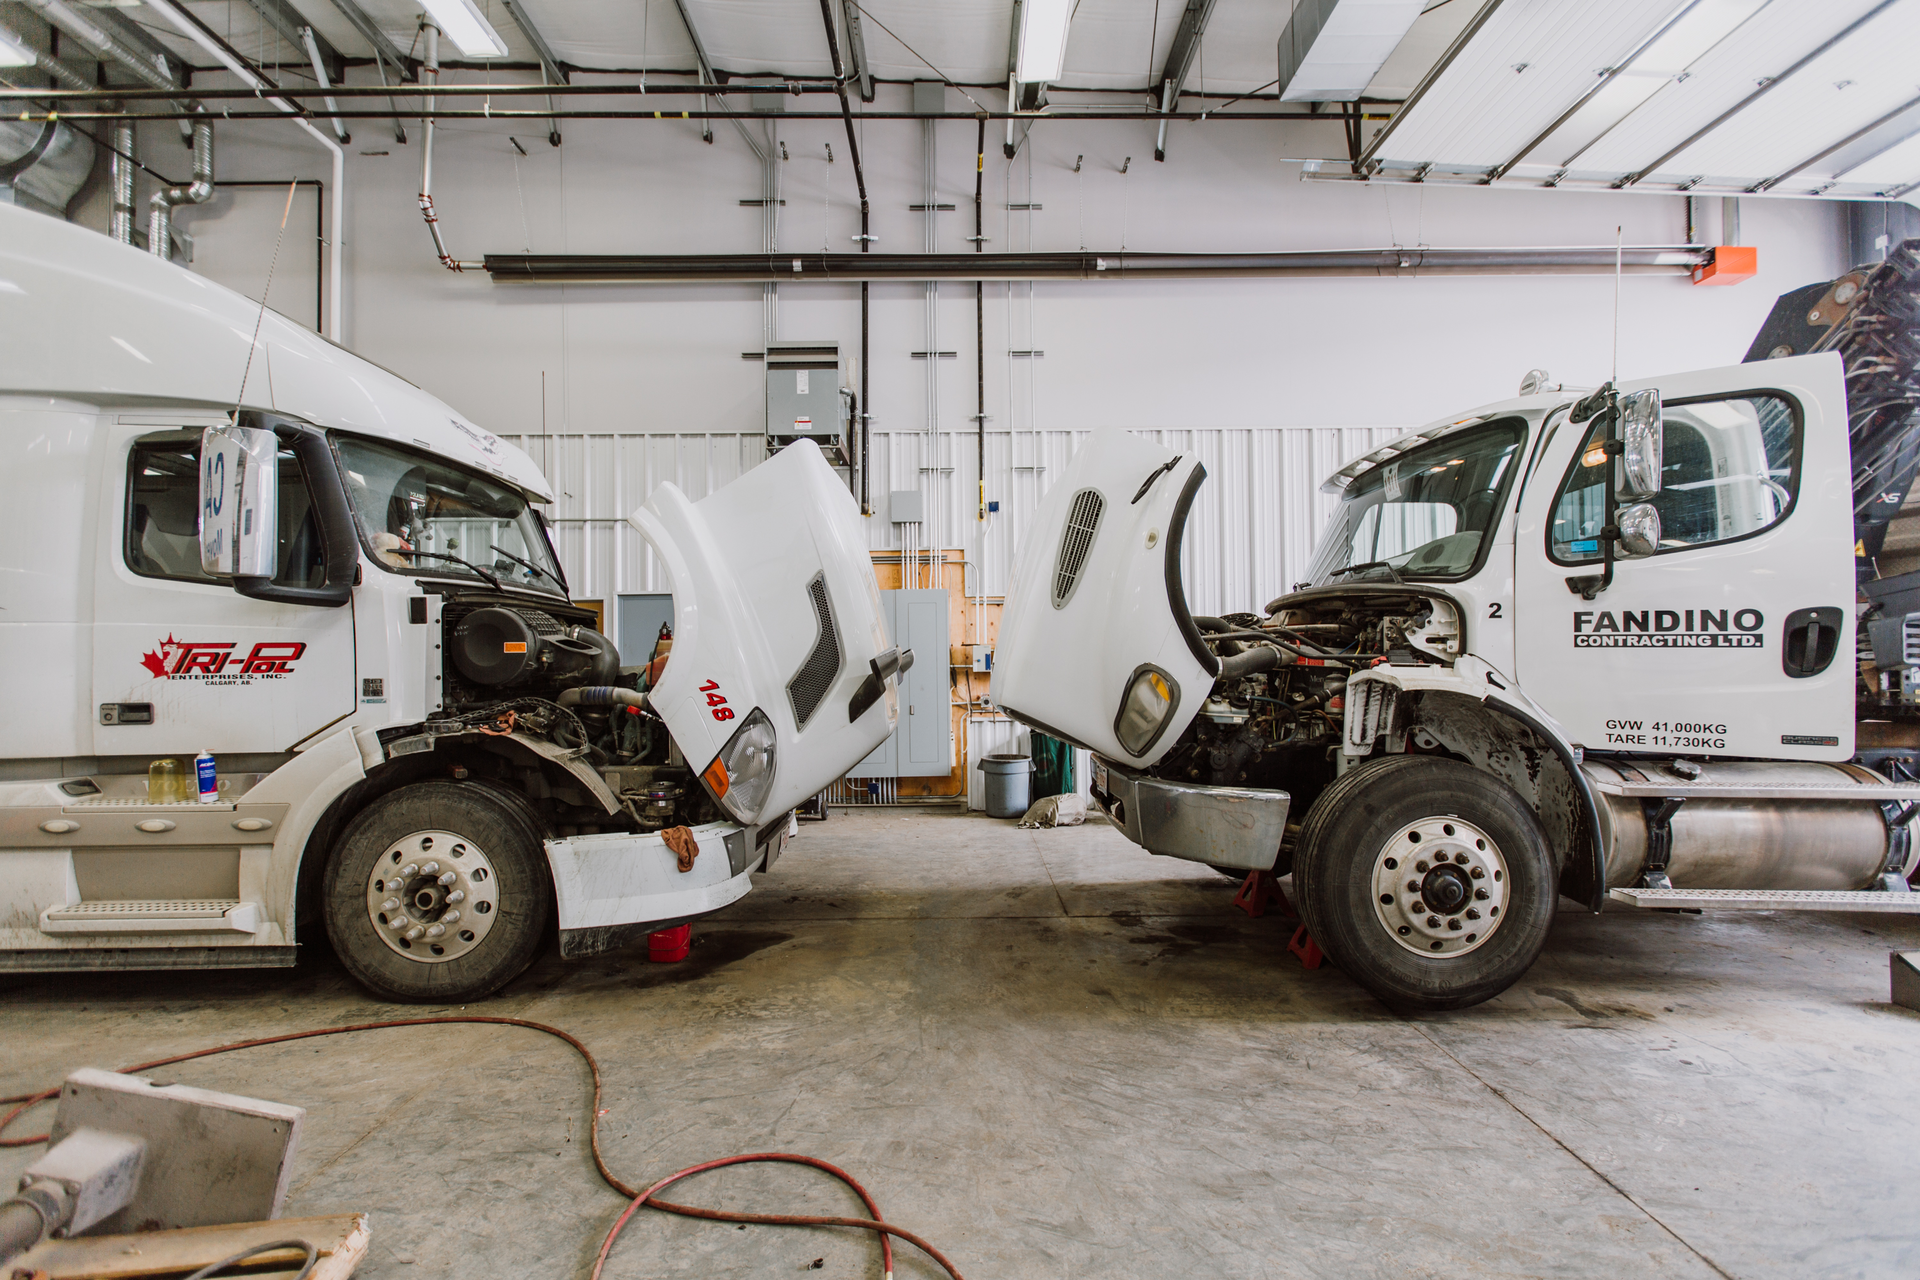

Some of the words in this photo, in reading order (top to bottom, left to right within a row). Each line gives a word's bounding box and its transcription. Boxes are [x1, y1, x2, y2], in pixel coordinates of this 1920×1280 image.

[1876, 492, 1901, 504] XS
[1488, 602, 1503, 619] 2
[1573, 608, 1764, 633] FANDINO
[1576, 635, 1712, 647] CONTRACTING
[1717, 635, 1761, 647] LTD.
[171, 673, 258, 681] ENTERPRISES,
[698, 678, 736, 722] 148
[1605, 720, 1644, 731] GVW
[1651, 722, 1727, 735] 41,000KG
[1606, 733, 1647, 745] TARE
[1652, 736, 1726, 749] 11,730KG
[142, 780, 231, 792] VOLO
